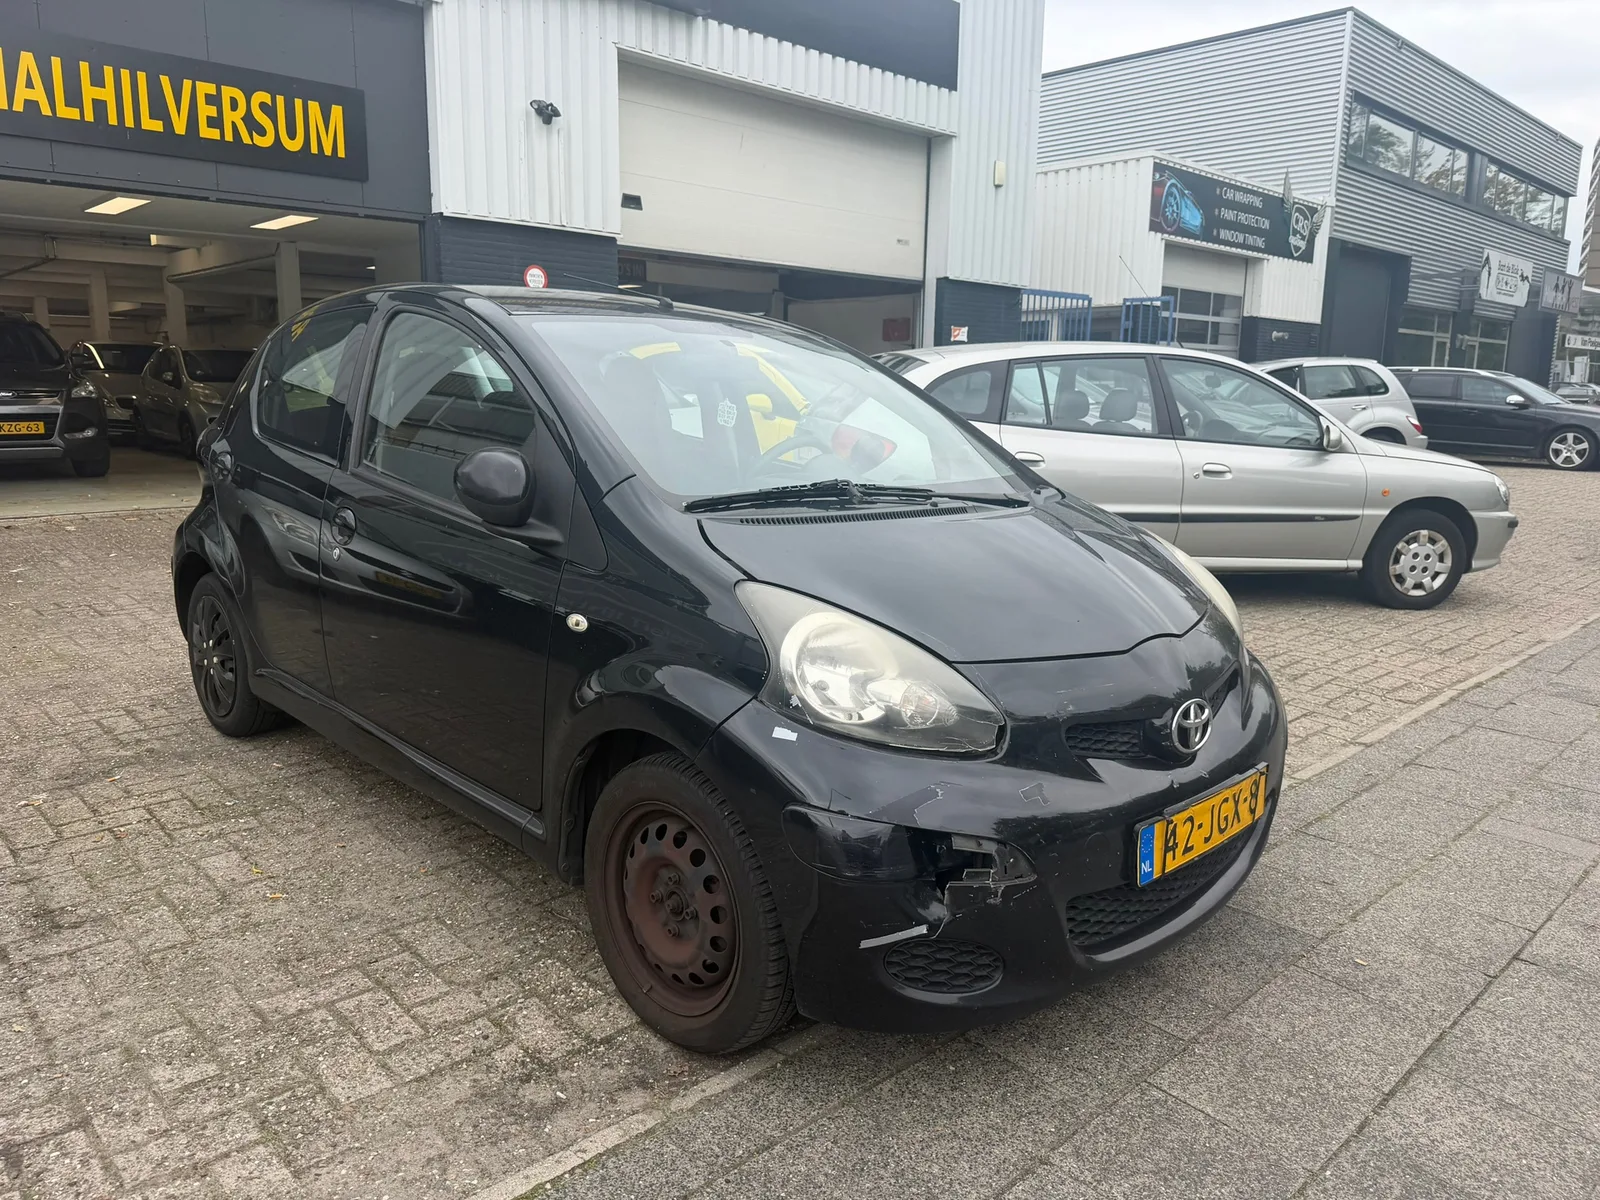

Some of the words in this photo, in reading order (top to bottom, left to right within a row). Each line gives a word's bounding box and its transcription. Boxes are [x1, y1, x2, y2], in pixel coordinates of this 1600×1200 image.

[0, 46, 346, 159] ALHILVERSUM
[1222, 187, 1234, 200] CAR
[1235, 190, 1263, 208] WRAPPING
[1220, 207, 1237, 222] PAINT
[1237, 211, 1270, 230] PROTECTION
[1219, 228, 1245, 244] WINDOW
[1245, 233, 1265, 248] TINTING
[1164, 778, 1259, 861] 42-JGX-8
[1141, 859, 1153, 875] NL
